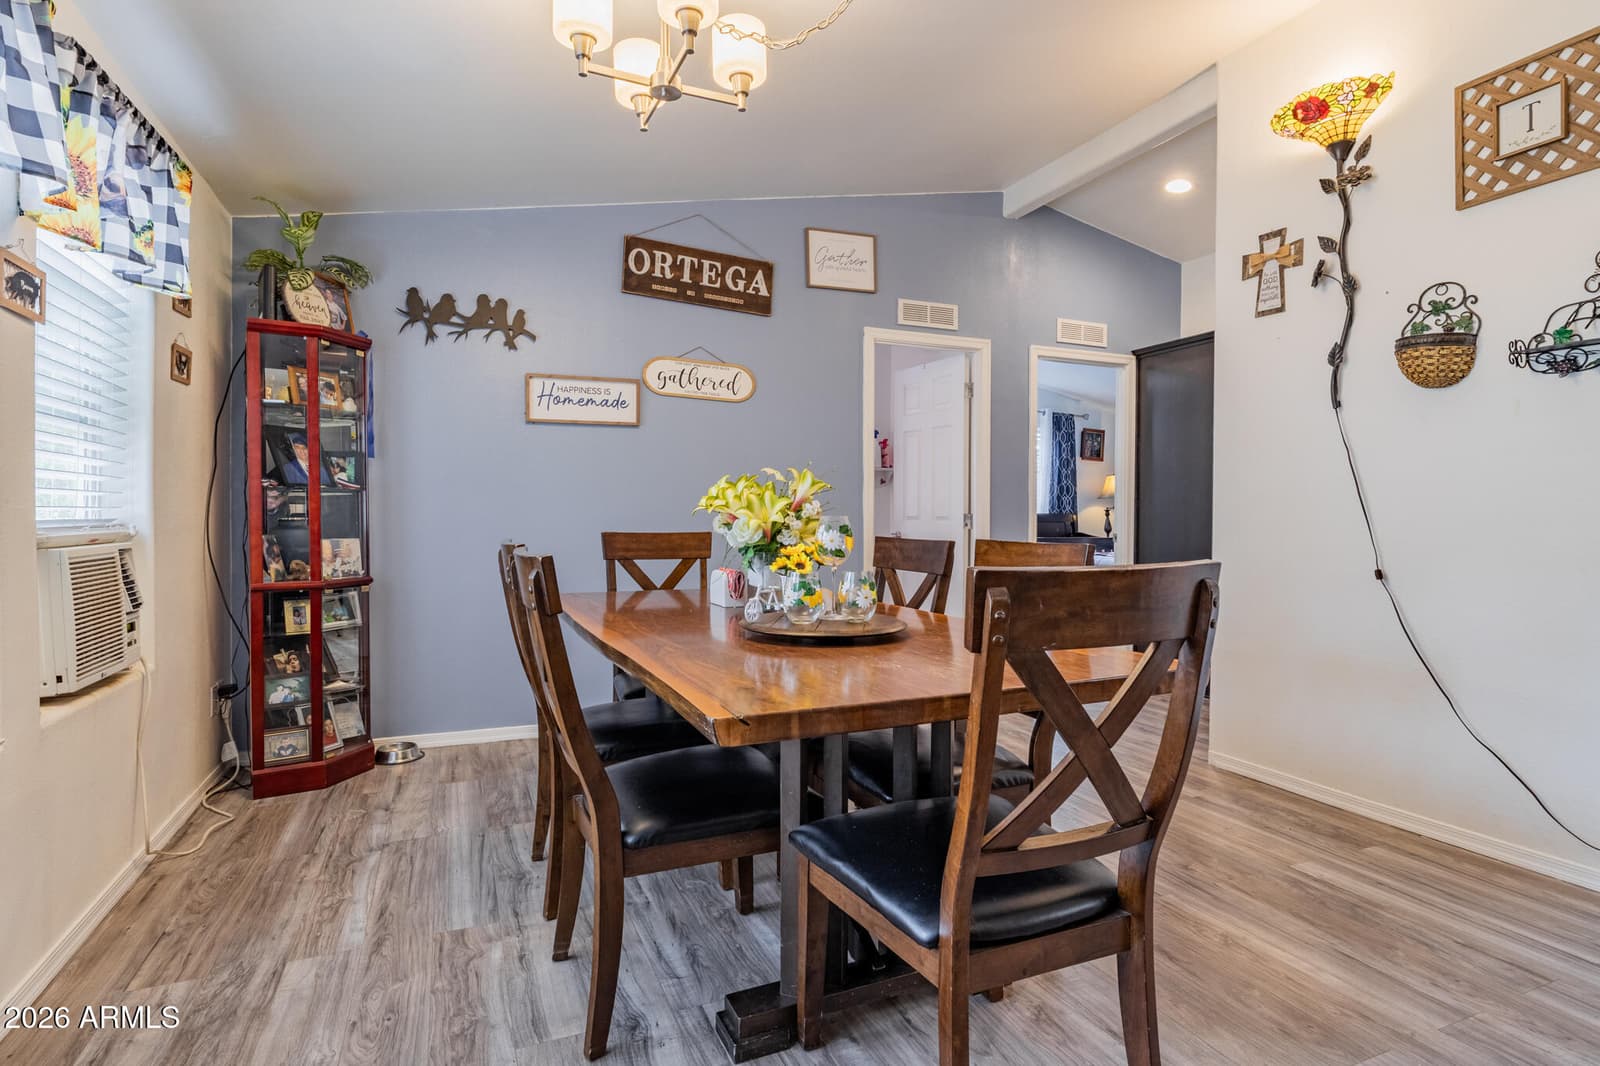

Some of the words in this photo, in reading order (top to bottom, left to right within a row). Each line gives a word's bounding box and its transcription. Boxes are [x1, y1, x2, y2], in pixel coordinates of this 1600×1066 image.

[627, 247, 770, 297] ORTEGA
[537, 380, 629, 411] Homemade
[557, 385, 602, 395] HAPPINESS
[603, 387, 612, 395] IS
[657, 366, 742, 396] gathered
